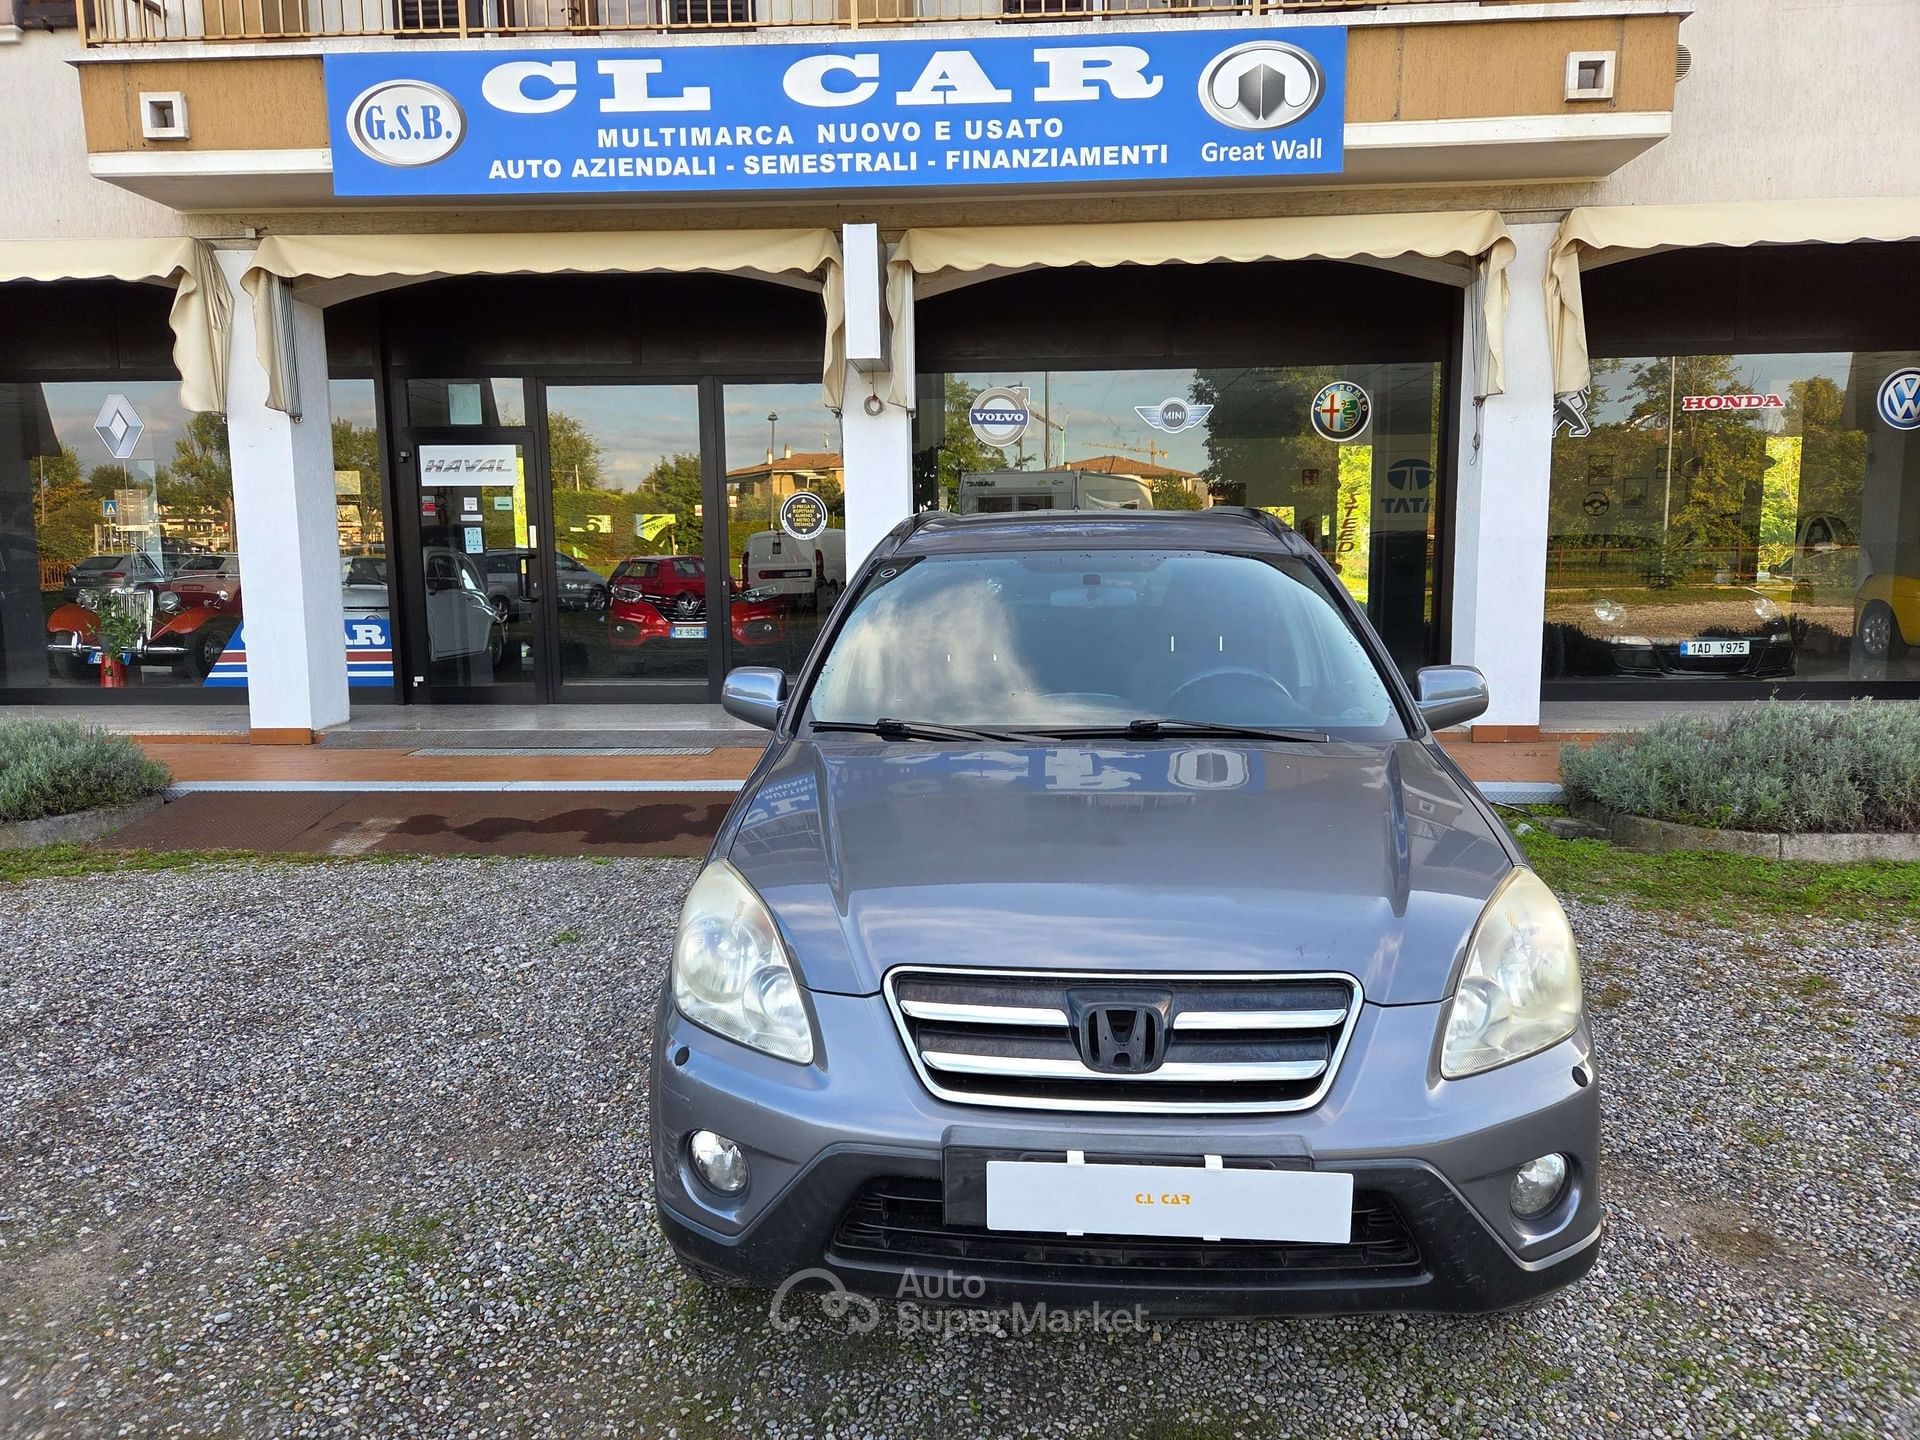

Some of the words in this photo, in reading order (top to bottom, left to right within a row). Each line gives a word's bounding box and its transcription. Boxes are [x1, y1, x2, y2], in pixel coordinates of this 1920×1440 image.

[481, 59, 712, 114] CL
[782, 45, 1164, 108] CAR
[365, 104, 453, 141] G.S.B.
[597, 124, 794, 148] MULTIMARCA
[817, 121, 921, 144] NUOVO
[934, 121, 951, 141] E
[964, 117, 1064, 141] USATO
[488, 159, 562, 179] AUTO
[571, 155, 716, 178] AZIENDALI
[743, 151, 918, 175] SEMESTRALI
[945, 144, 1168, 170] FINANZIAMENTI
[1201, 141, 1265, 162] Great
[1271, 138, 1322, 160] Wall
[1314, 389, 1332, 413] ALFA
[1338, 384, 1369, 412] ROMEO
[1683, 395, 1783, 410] HONDA
[973, 412, 1025, 422] VOLVO
[1163, 411, 1185, 420] MINI
[424, 459, 512, 473] HAVAL
[1691, 643, 1711, 654] 1AD
[1719, 642, 1745, 654] Y975
